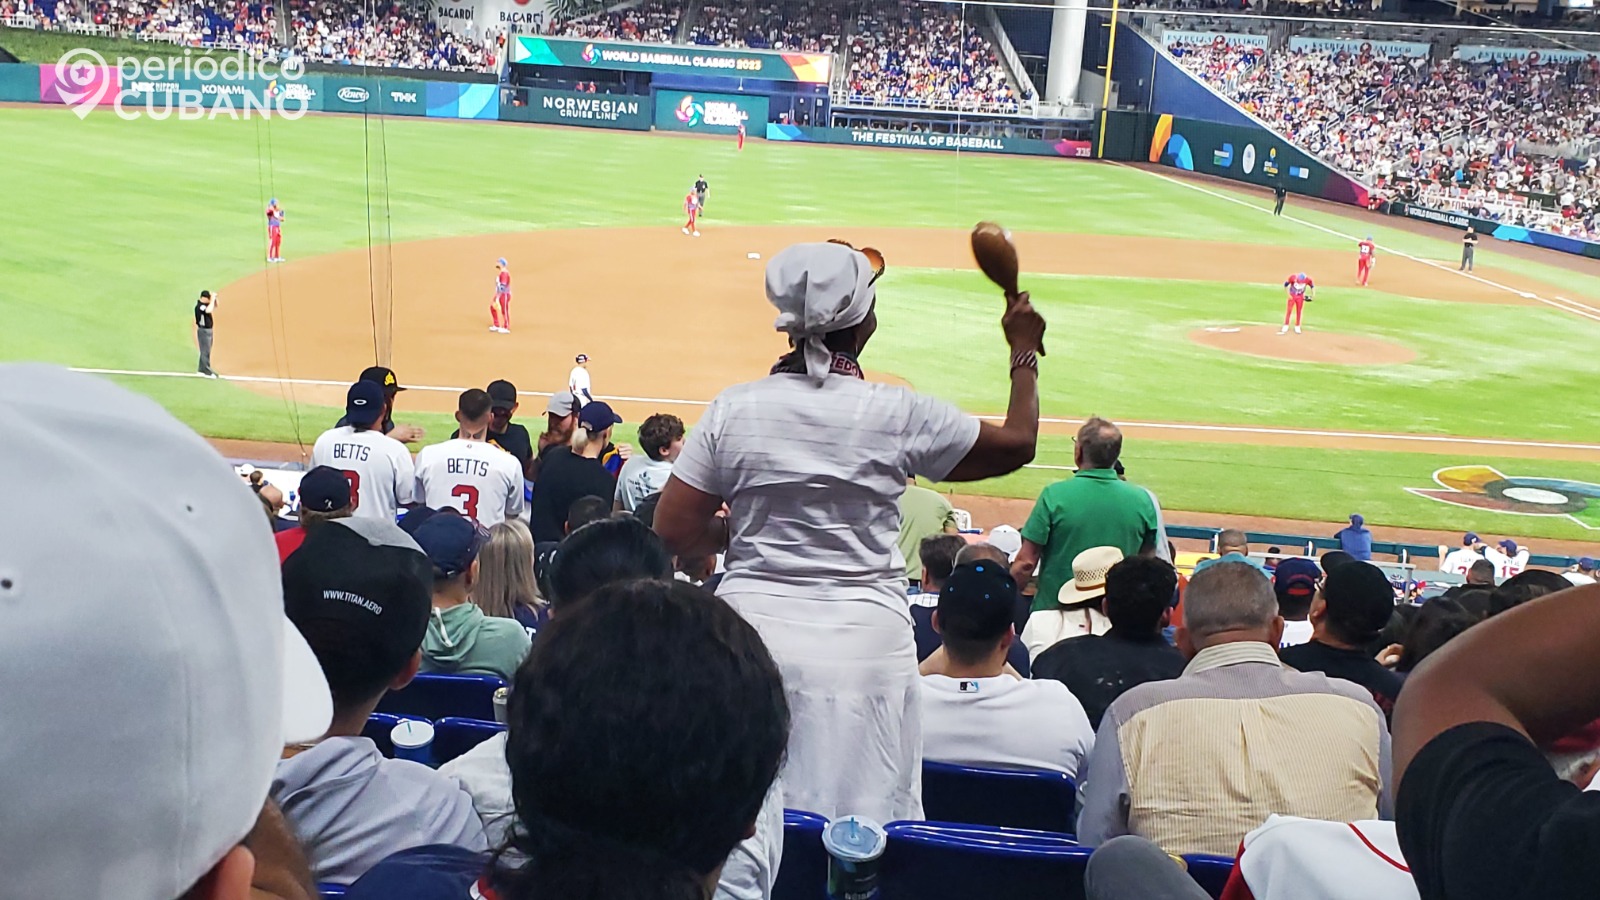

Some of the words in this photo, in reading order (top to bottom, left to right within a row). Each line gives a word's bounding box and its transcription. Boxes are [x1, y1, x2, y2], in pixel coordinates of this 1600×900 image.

[438, 6, 474, 20] BACARDÍ
[602, 50, 639, 62] WORLD
[640, 53, 692, 66] BASEBALL
[692, 56, 735, 69] CLASSIC
[736, 59, 761, 70] 2023
[202, 84, 245, 95] KONAMI
[543, 96, 638, 114] NORWEGIAN
[704, 101, 737, 110] WORLD
[560, 109, 592, 118] CRUISE
[596, 112, 617, 120] LINE
[852, 131, 873, 142] THE
[875, 133, 927, 145] FESTIVAL
[929, 136, 944, 146] OF
[946, 136, 1004, 149] BASEBALL
[333, 443, 371, 462] BETTS
[447, 458, 489, 477] BETTS
[451, 484, 479, 520] 3
[323, 590, 383, 615] WWW.TITAN.AERO
